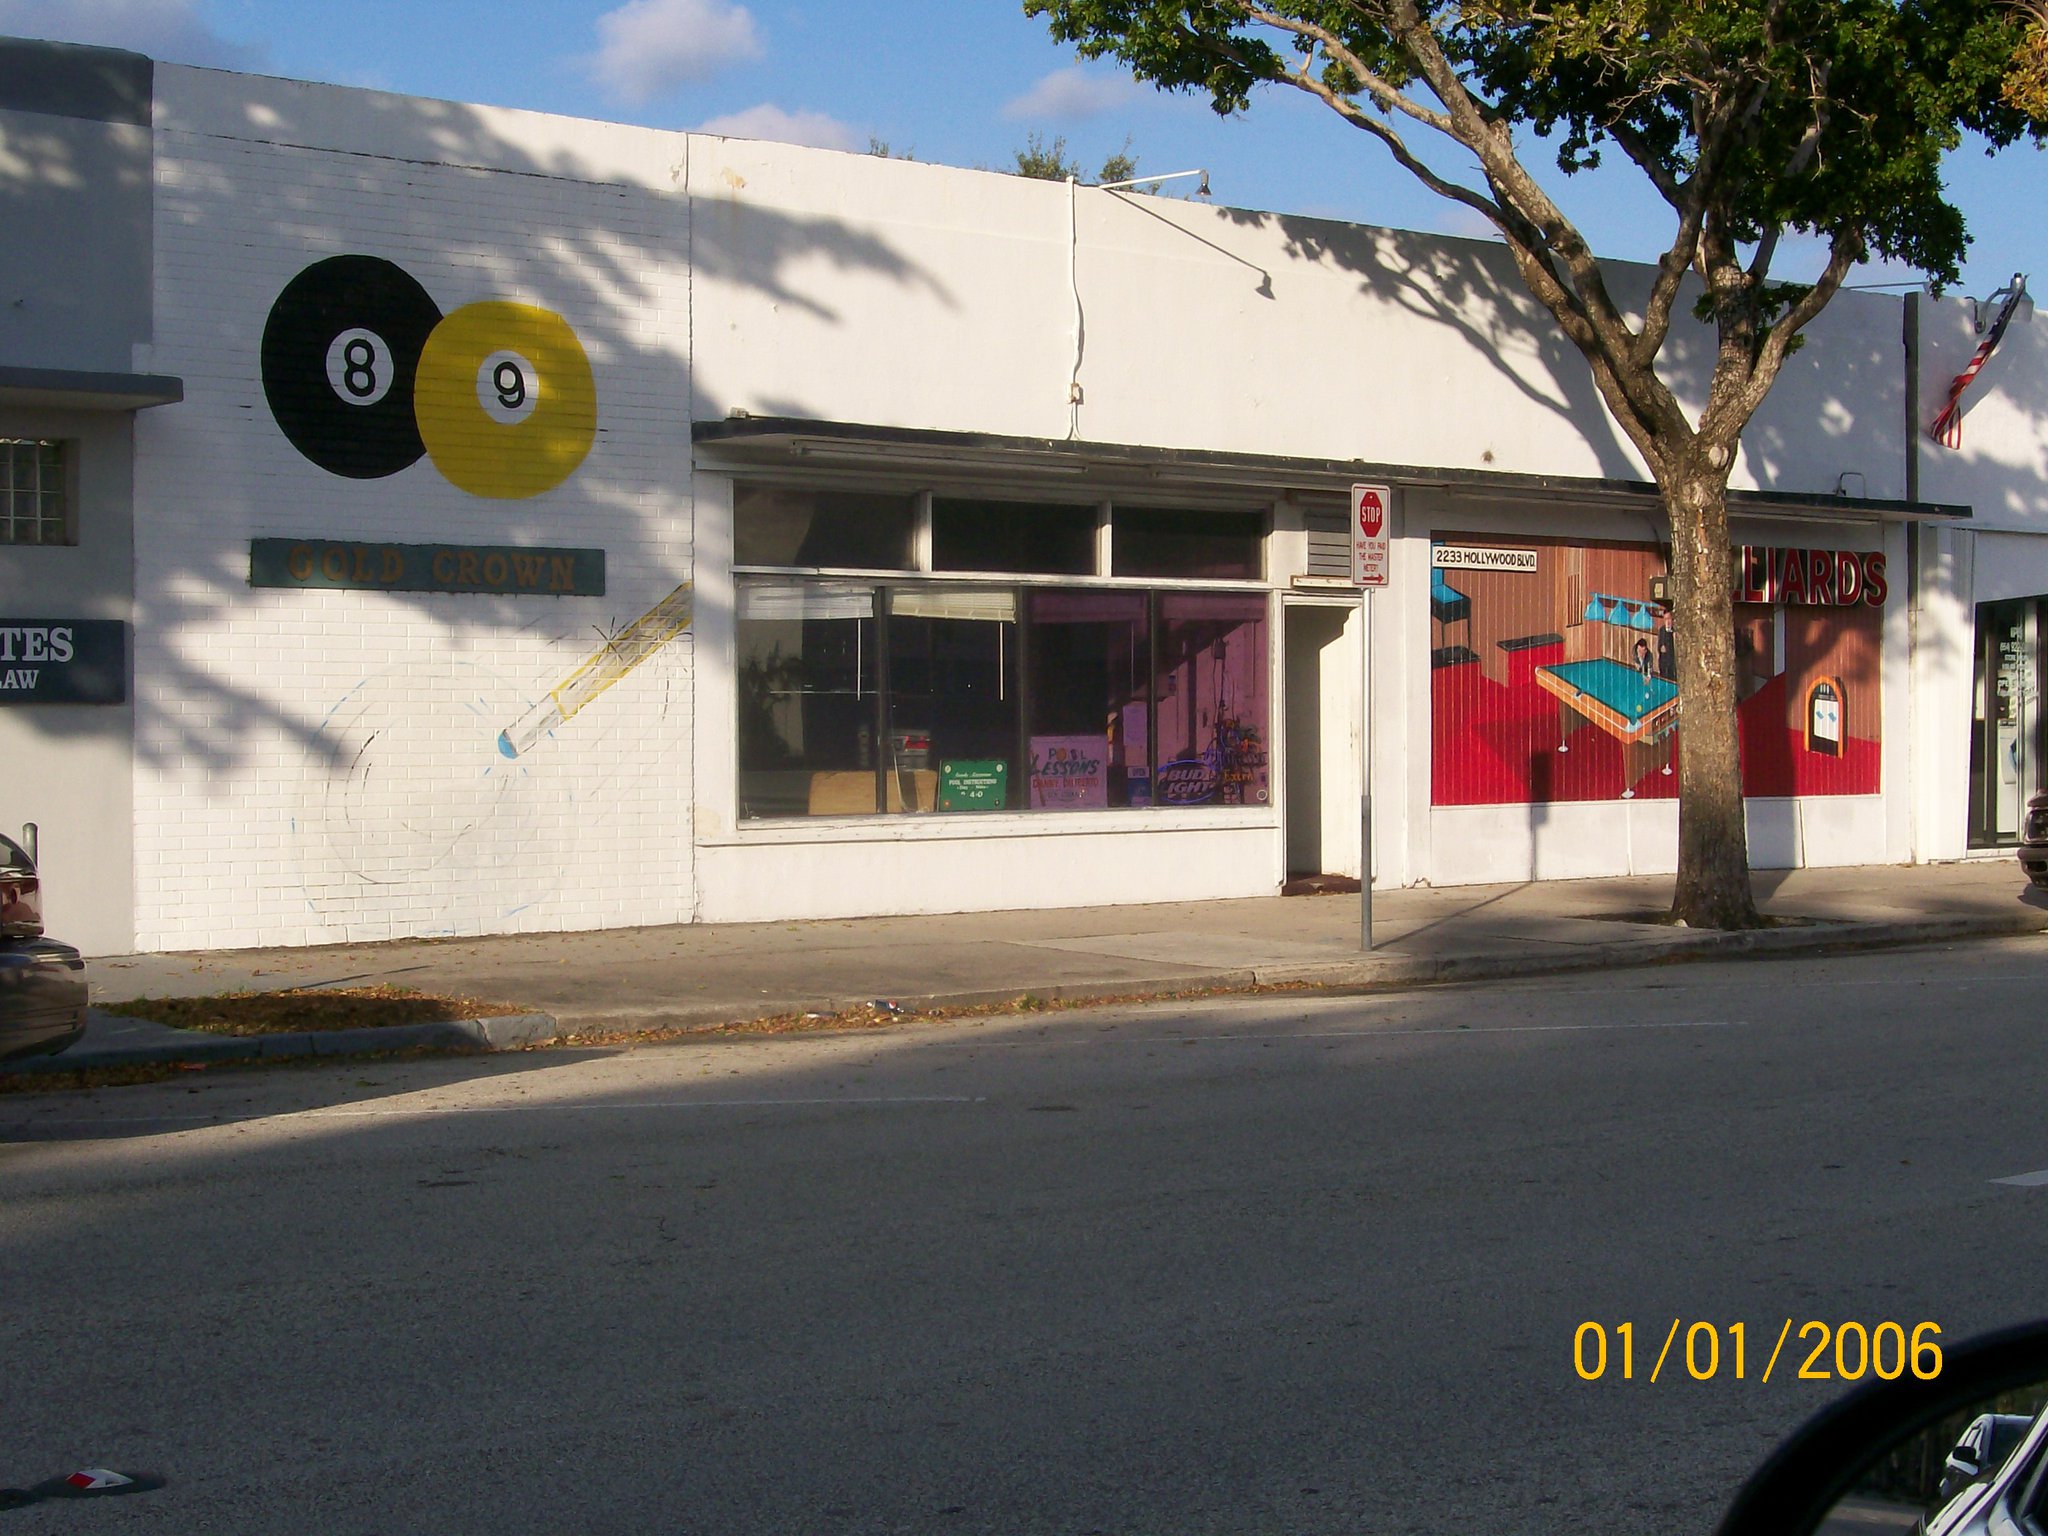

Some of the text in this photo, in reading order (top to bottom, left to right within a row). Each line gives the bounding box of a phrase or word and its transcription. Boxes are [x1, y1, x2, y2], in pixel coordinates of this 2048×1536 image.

[344, 338, 376, 397] 8
[493, 361, 526, 409] 9
[1361, 506, 1381, 523] STOP
[1436, 550, 1535, 567] 2233 HOLLYWOOD BLVD.
[289, 546, 576, 590] GOLD CROWN
[1732, 545, 1888, 607] LIARDS
[0, 669, 39, 689] AW
[1048, 747, 1087, 761] POOL
[1167, 769, 1205, 780] BUD
[1167, 781, 1210, 793] IGHT
